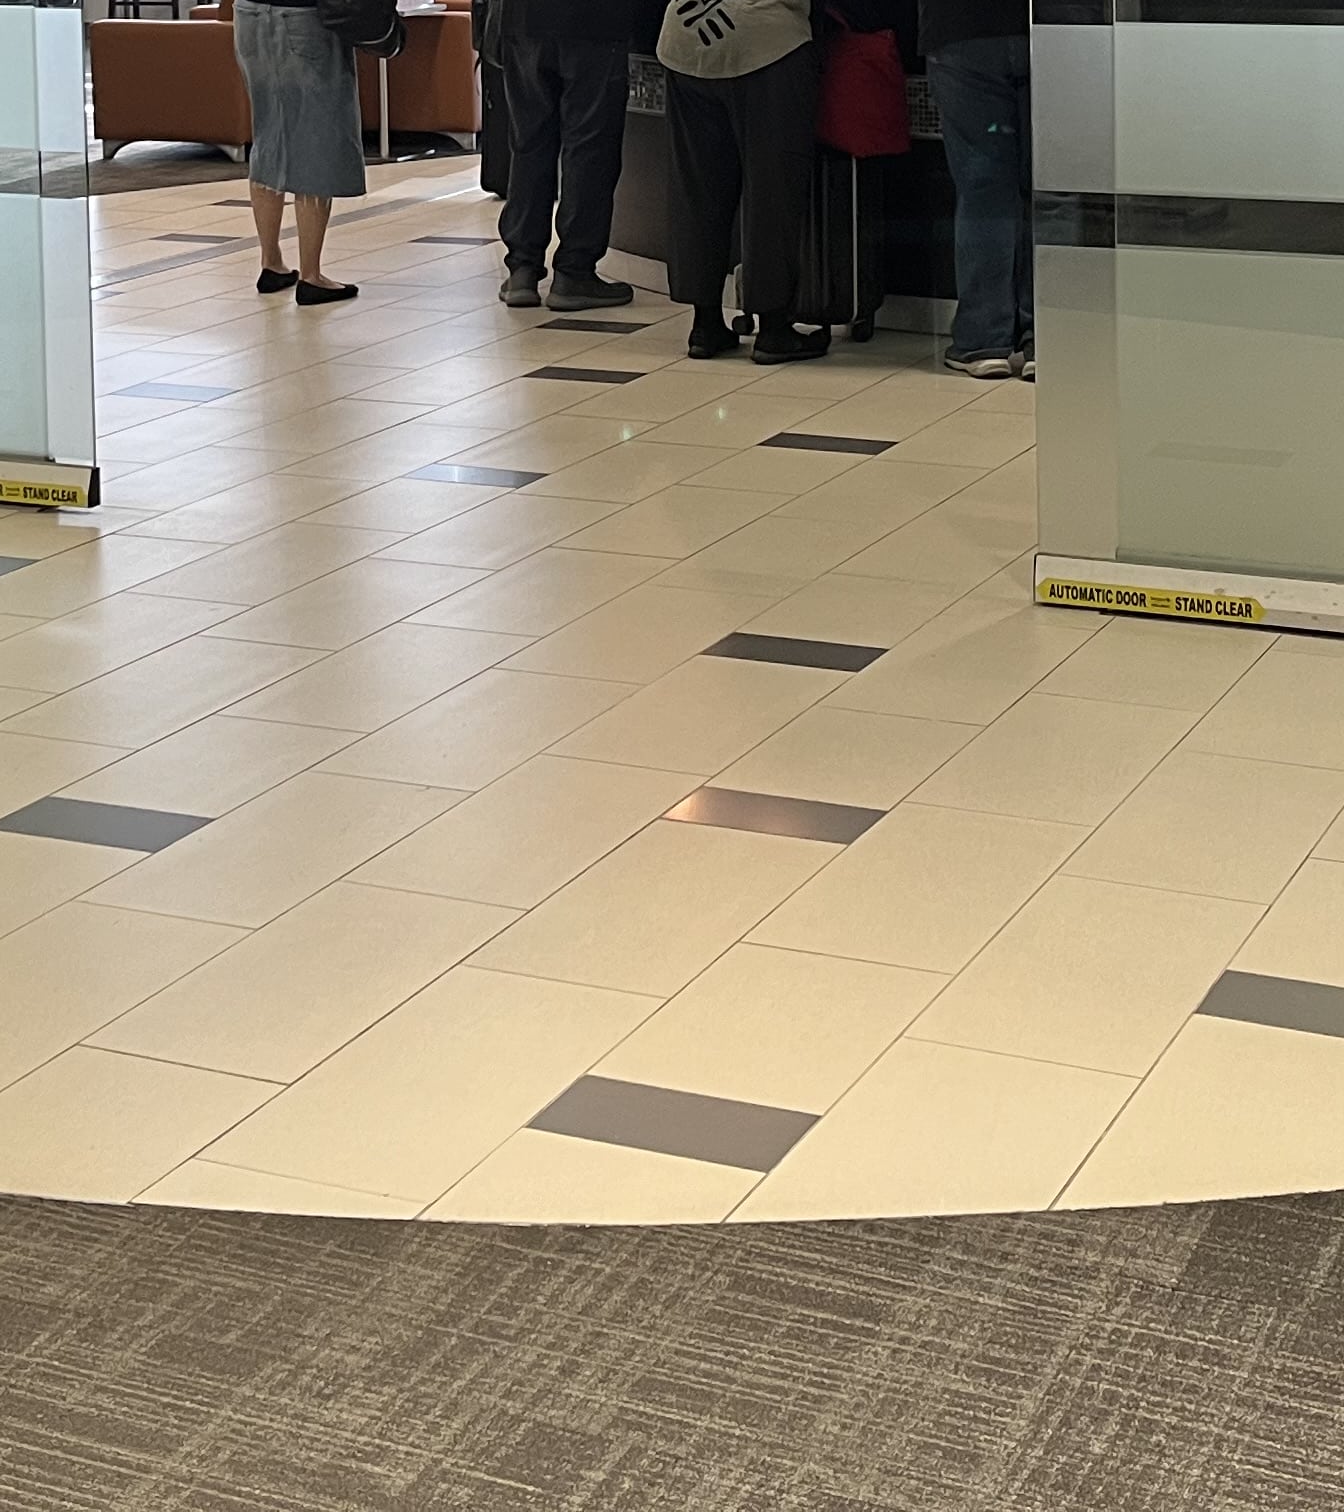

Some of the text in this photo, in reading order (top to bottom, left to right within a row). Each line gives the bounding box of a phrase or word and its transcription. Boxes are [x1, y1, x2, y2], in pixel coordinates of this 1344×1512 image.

[23, 486, 50, 500] STAND
[51, 490, 78, 503] CLEAR
[1049, 584, 1113, 603] AUTOMATIC
[1116, 590, 1147, 607] DOOR
[1175, 596, 1213, 614] STAND
[1215, 601, 1253, 618] CLEAR
